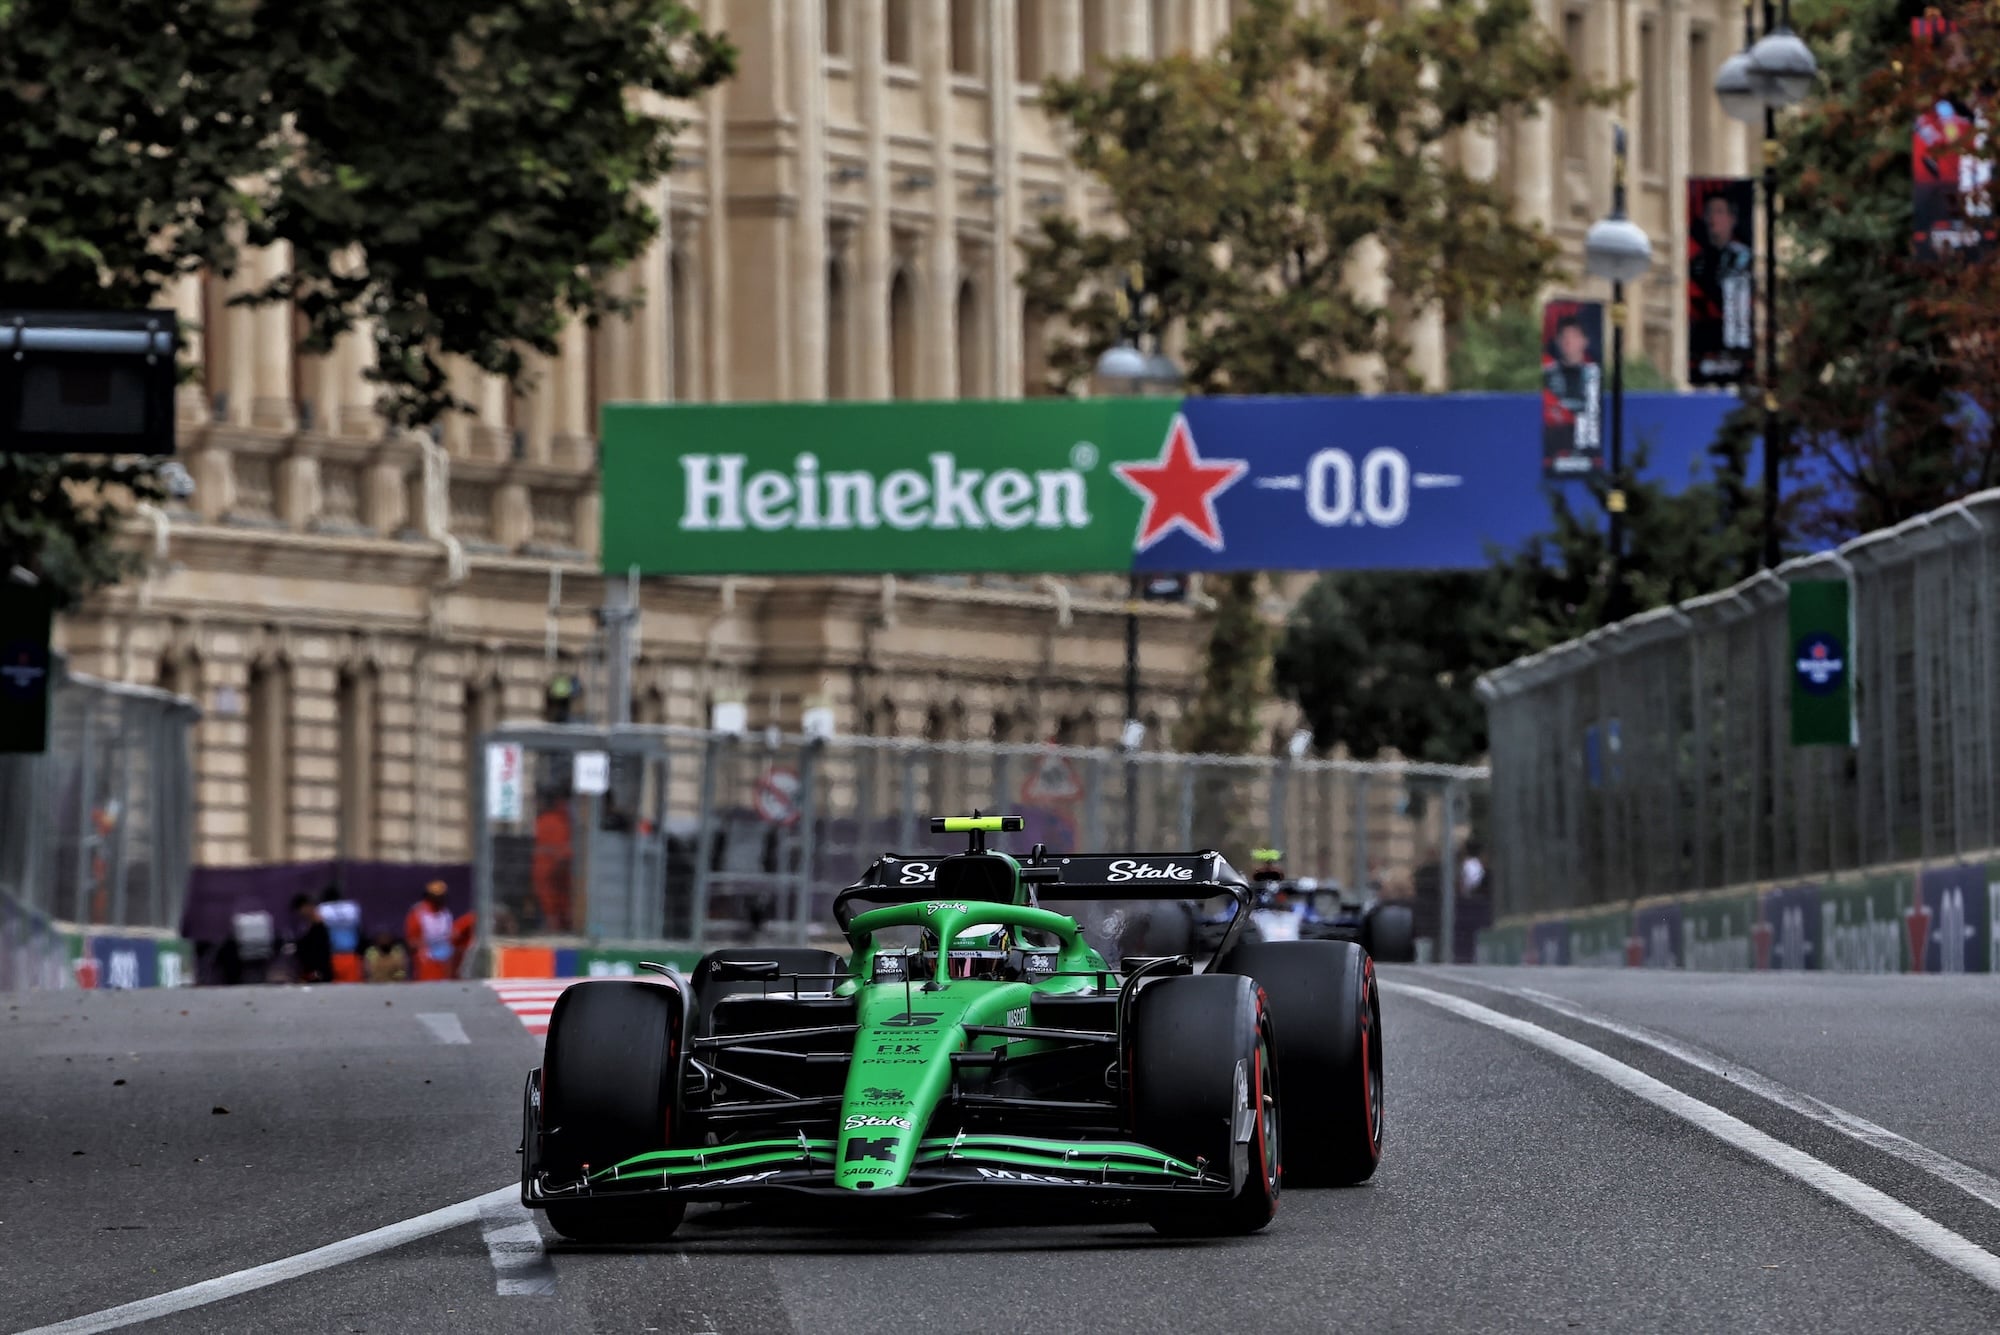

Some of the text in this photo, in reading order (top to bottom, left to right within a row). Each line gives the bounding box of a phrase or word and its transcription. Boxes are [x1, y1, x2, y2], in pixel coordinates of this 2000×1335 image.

[1107, 860, 1194, 882] Stake
[926, 902, 969, 916] Stake
[879, 1012, 945, 1027] 5
[877, 1044, 922, 1053] FIX
[843, 1113, 913, 1132] Stake
[842, 1167, 894, 1178] SAUBER
